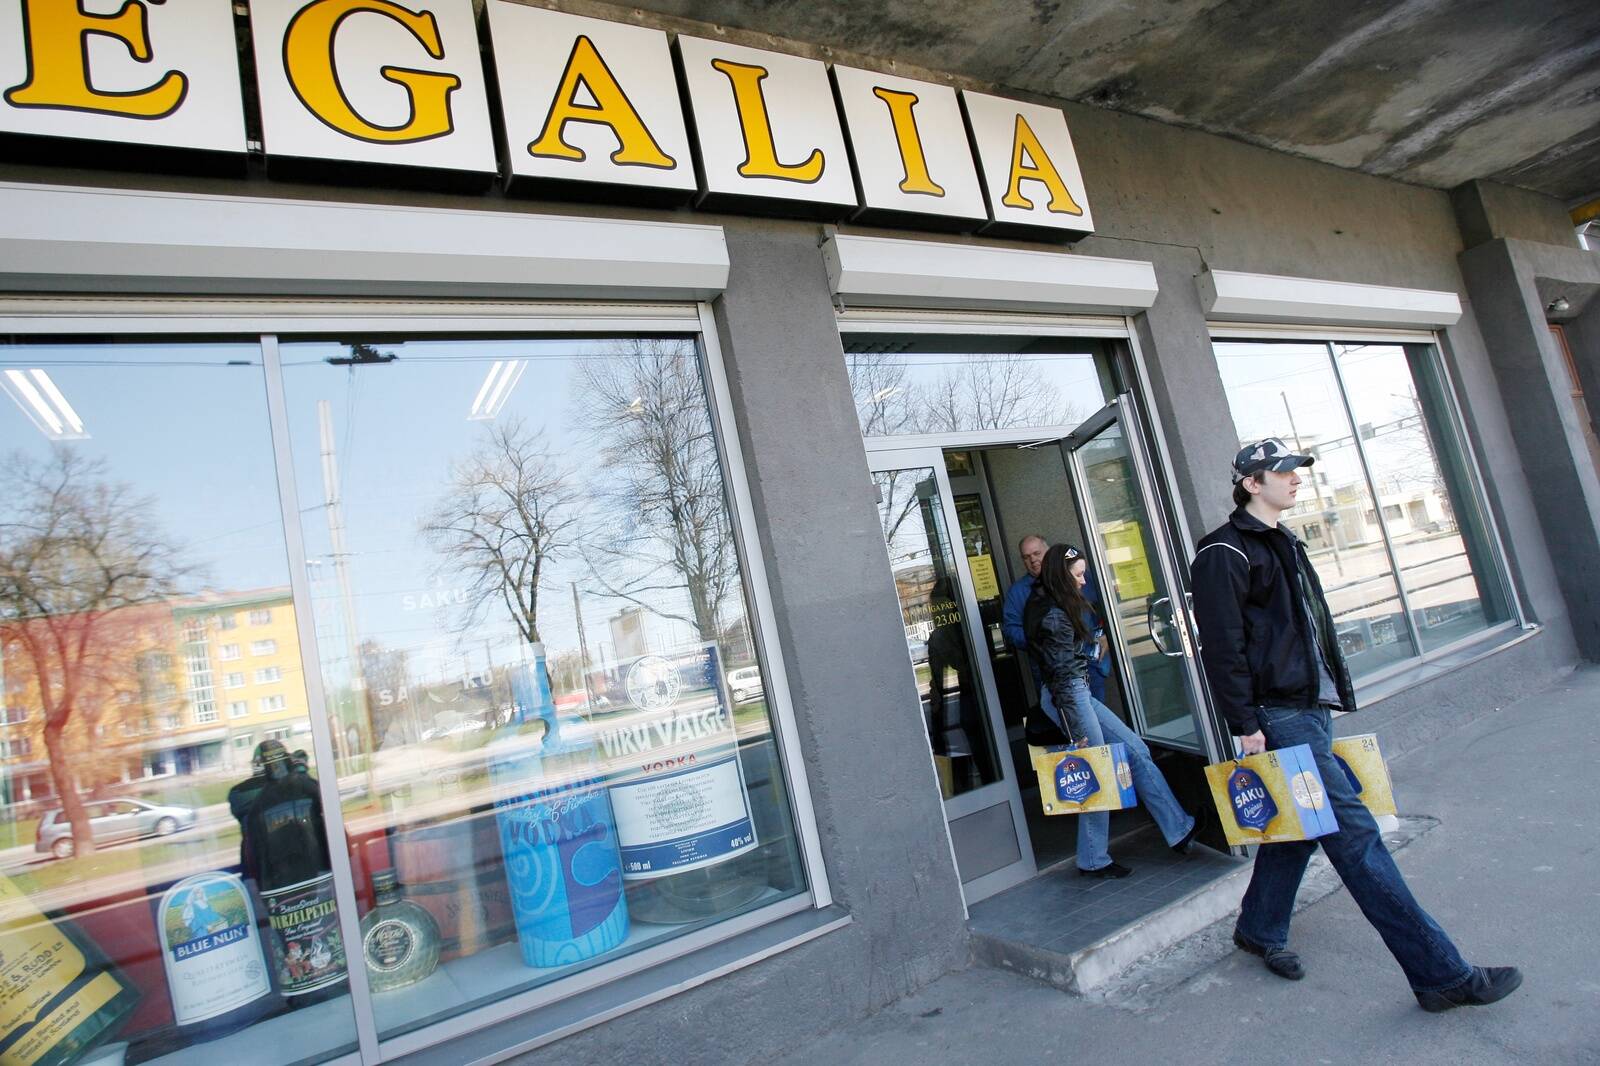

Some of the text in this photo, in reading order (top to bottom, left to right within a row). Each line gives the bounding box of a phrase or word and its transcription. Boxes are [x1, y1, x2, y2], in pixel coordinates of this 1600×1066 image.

[4, 0, 1083, 217] EGALIA
[402, 588, 468, 610] SAKU
[935, 611, 961, 627] 23.00
[1100, 747, 1109, 755] 24
[1361, 737, 1374, 748] 24
[641, 753, 697, 774] VODKA
[1267, 752, 1277, 763] 24
[1059, 770, 1091, 788] SAKU
[1066, 781, 1087, 794] Original
[1234, 787, 1265, 809] SAKU
[1243, 799, 1264, 819] Original
[730, 832, 752, 848] 40% vol
[629, 860, 652, 872] 500 ml
[177, 928, 243, 957] BLUE NUN
[22, 949, 53, 973] RUDD
